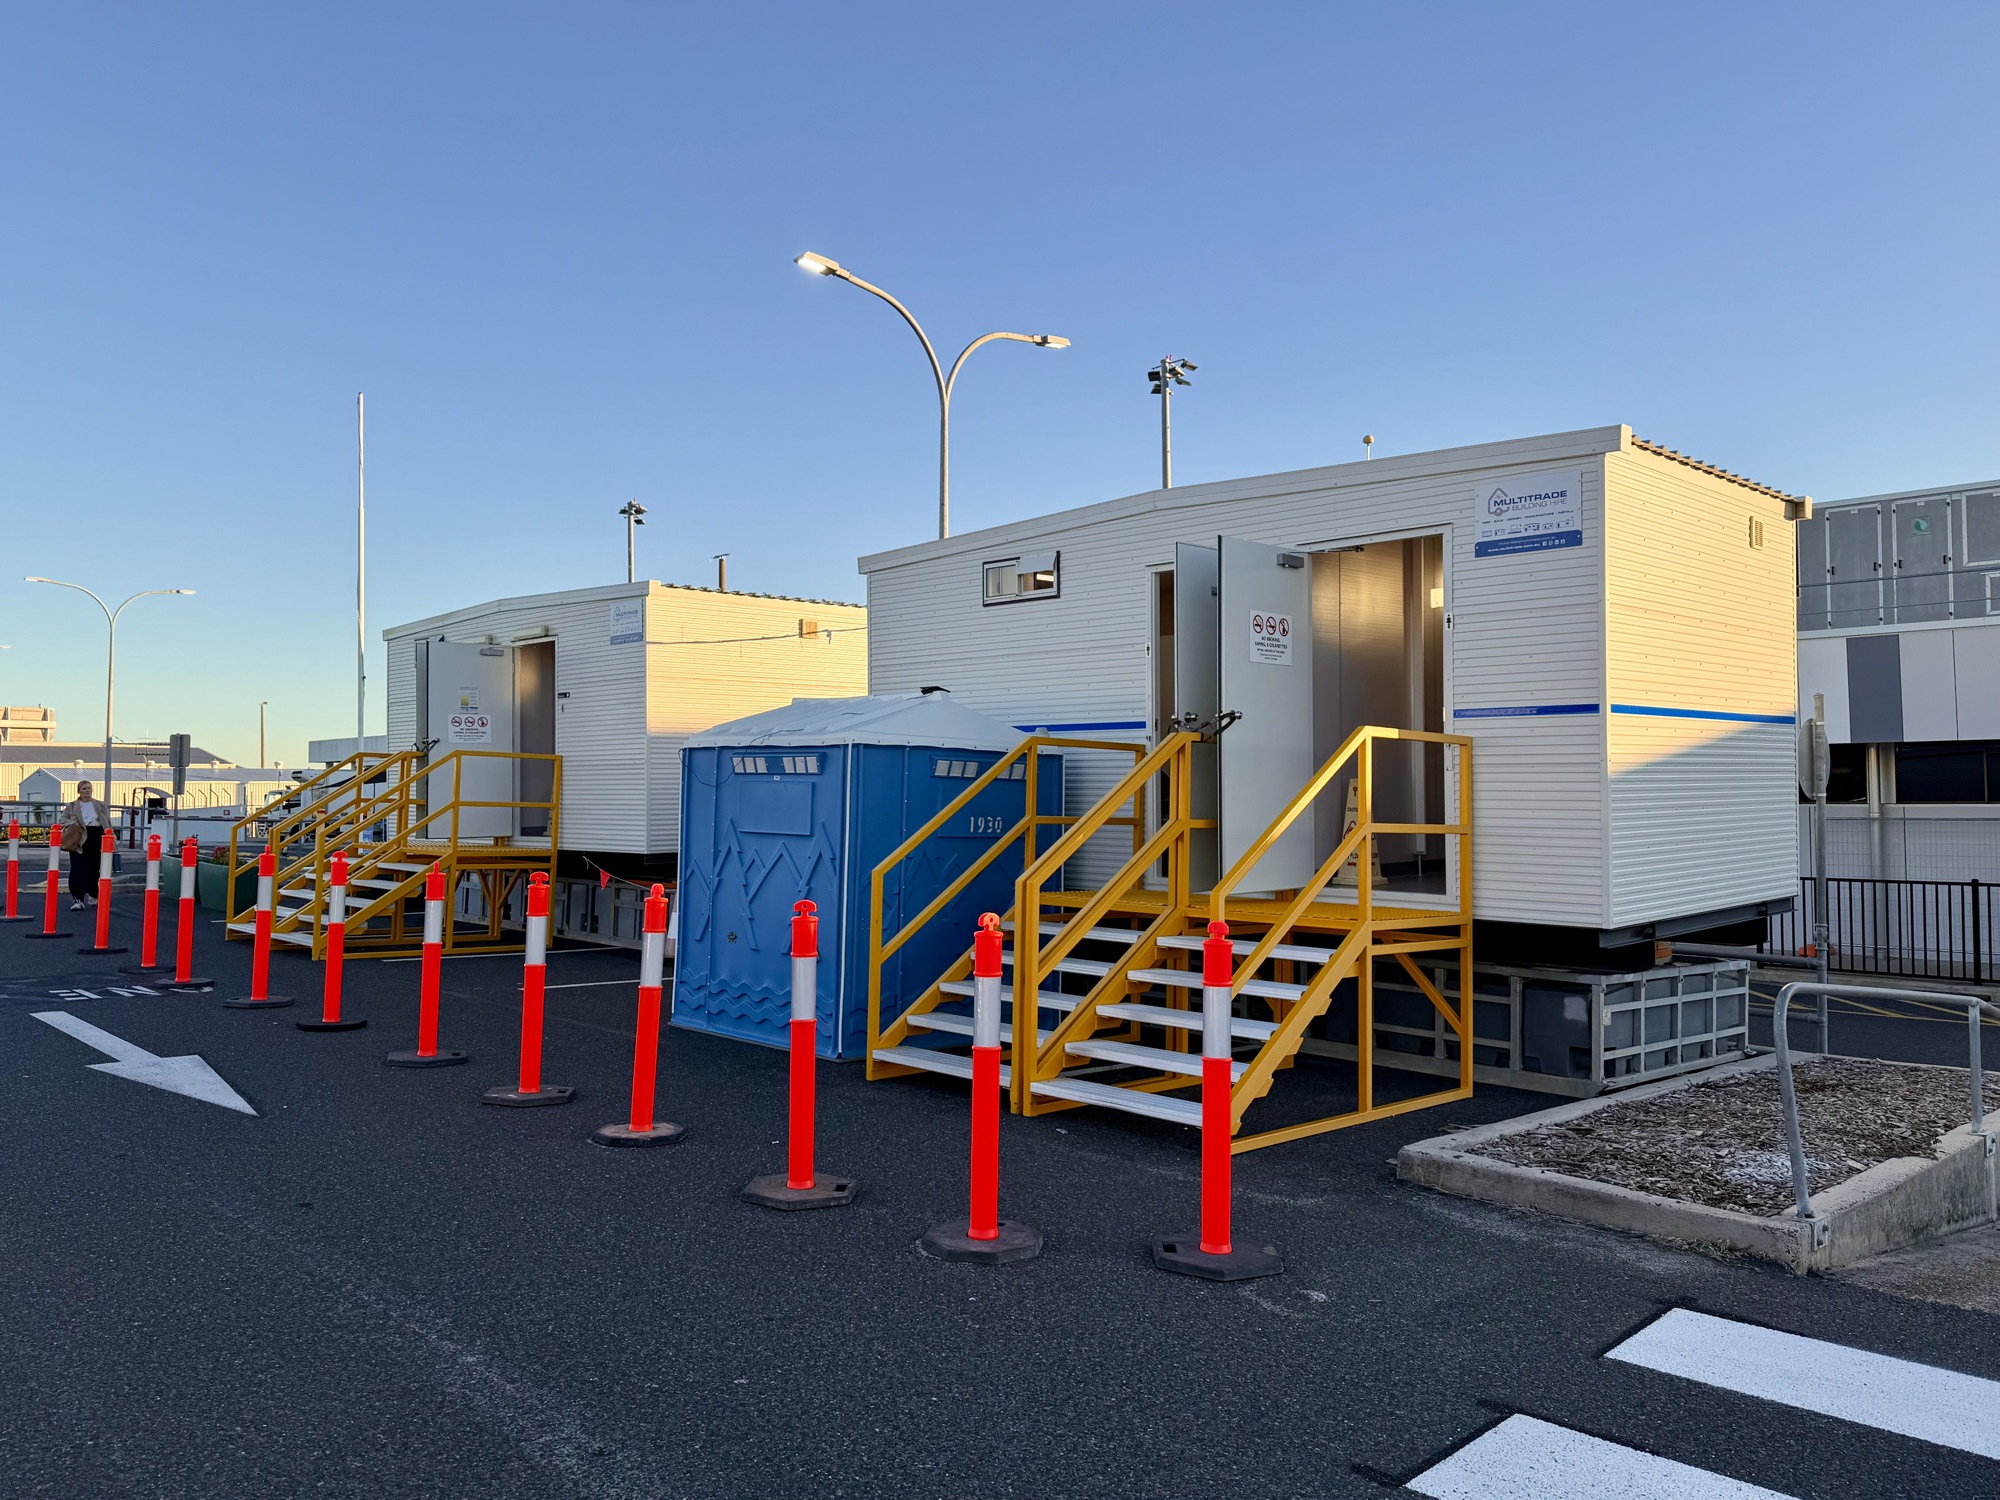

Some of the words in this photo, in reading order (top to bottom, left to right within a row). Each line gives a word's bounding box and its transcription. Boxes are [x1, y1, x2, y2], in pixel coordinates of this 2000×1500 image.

[1493, 490, 1568, 507] MULTITRADE
[1512, 501, 1548, 511] BUILDING
[1549, 498, 1568, 506] HIRE
[970, 816, 1003, 833] 1930
